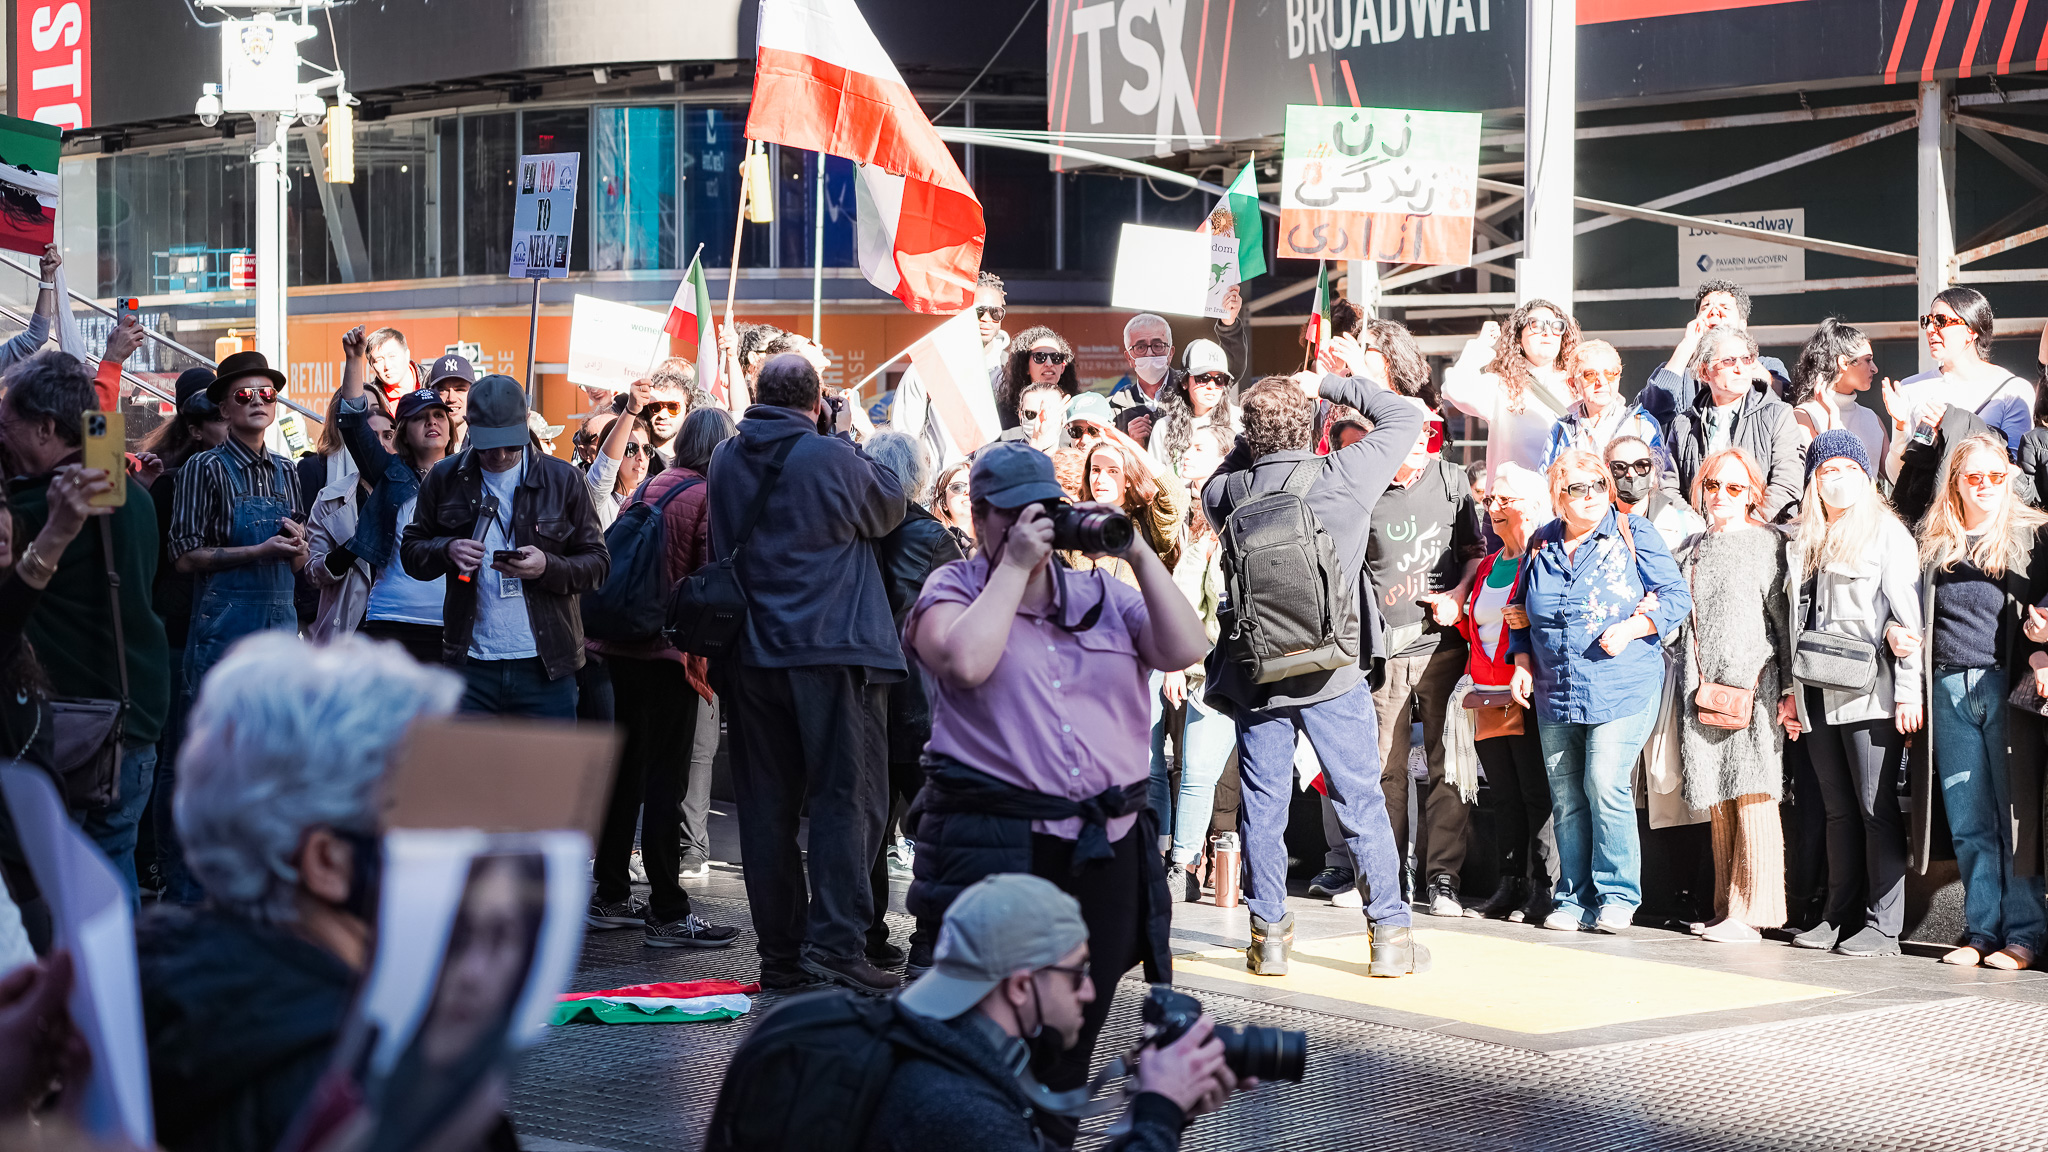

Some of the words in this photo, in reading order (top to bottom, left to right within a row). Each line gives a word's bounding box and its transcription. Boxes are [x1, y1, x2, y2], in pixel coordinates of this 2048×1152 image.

[1072, 0, 1208, 158] TSX
[1333, 113, 1412, 157] زن
[538, 160, 555, 193] NO
[1295, 156, 1435, 212] زندگی
[536, 198, 551, 231] TO
[527, 234, 554, 268] NIAC
[1211, 243, 1236, 254] dom.
[1716, 257, 1746, 266] PAVARINI
[290, 362, 336, 394] RETAIL
[1386, 515, 1417, 543] زن
[1397, 521, 1441, 572] زندگی
